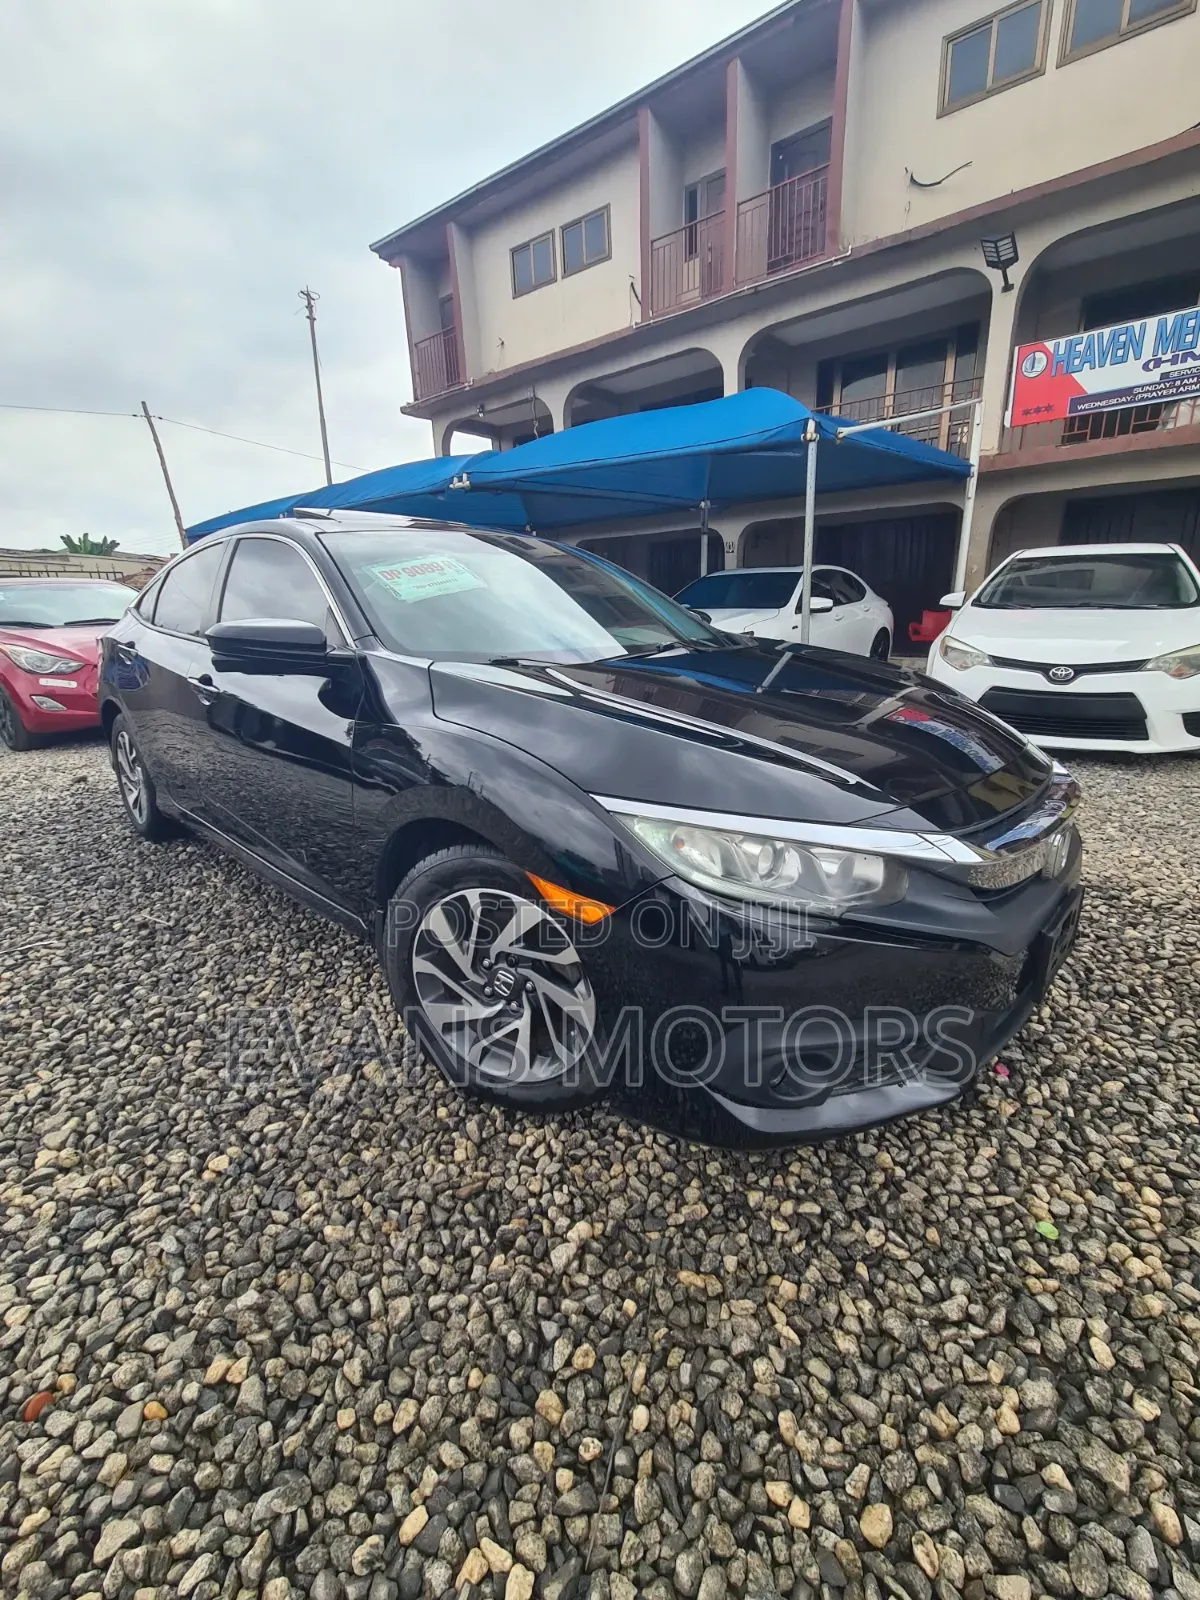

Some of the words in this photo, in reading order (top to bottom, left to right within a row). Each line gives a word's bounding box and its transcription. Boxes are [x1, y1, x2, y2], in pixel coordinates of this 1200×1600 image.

[1051, 322, 1147, 377] HEAVEN
[1133, 381, 1174, 394] SUNDAY:
[1181, 377, 1197, 385] AM
[1077, 396, 1135, 410] WEDNESDAY:
[1135, 387, 1176, 401] (PRAYER
